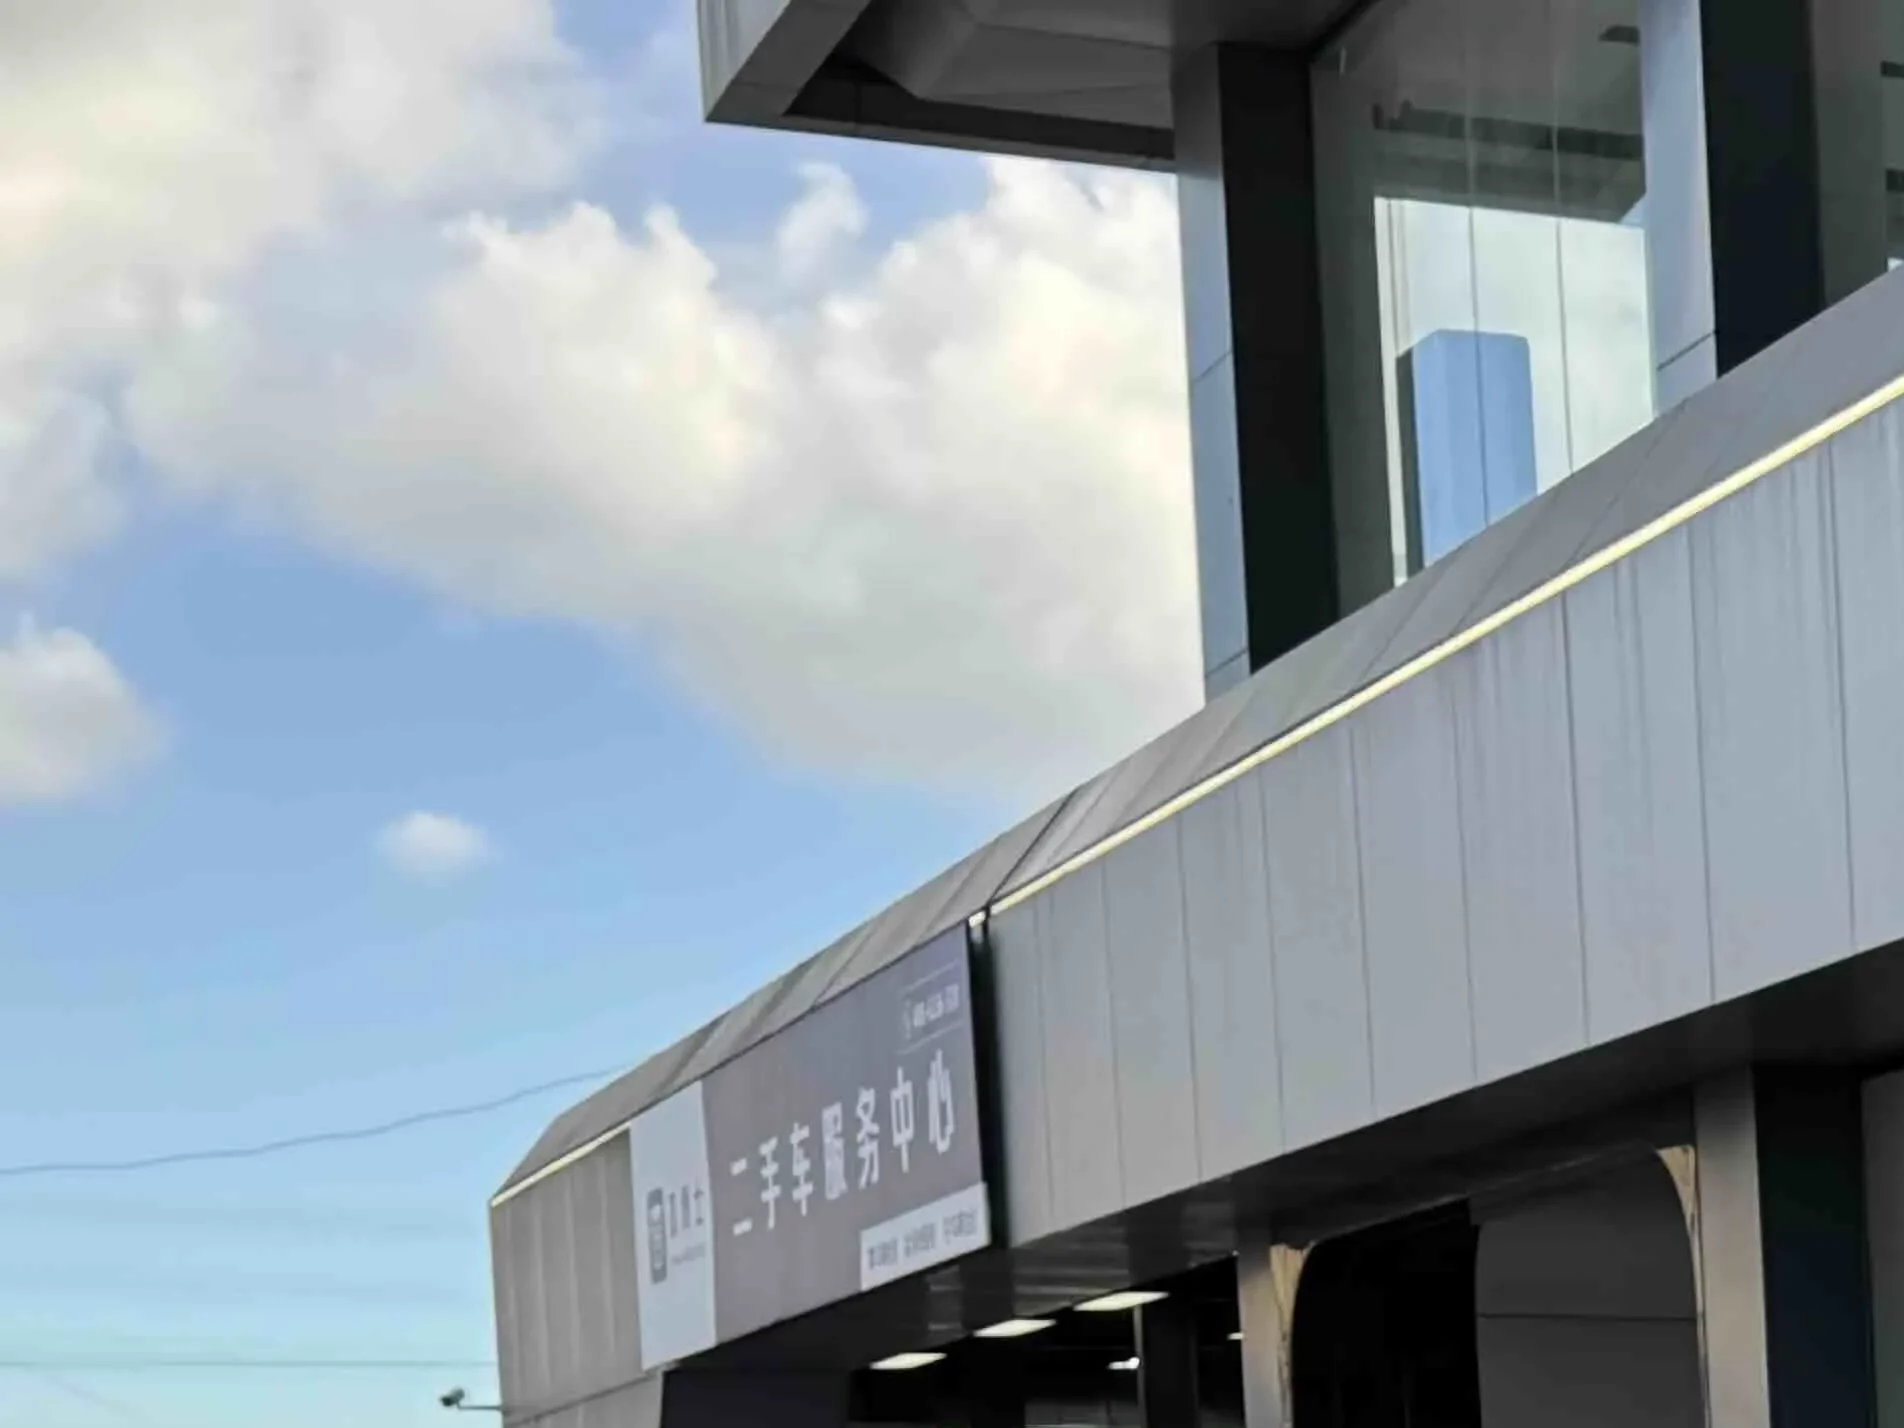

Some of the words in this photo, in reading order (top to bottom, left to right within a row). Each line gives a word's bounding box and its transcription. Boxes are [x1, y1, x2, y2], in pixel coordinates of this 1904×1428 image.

[730, 1047, 955, 1237] 二手车服务中心
